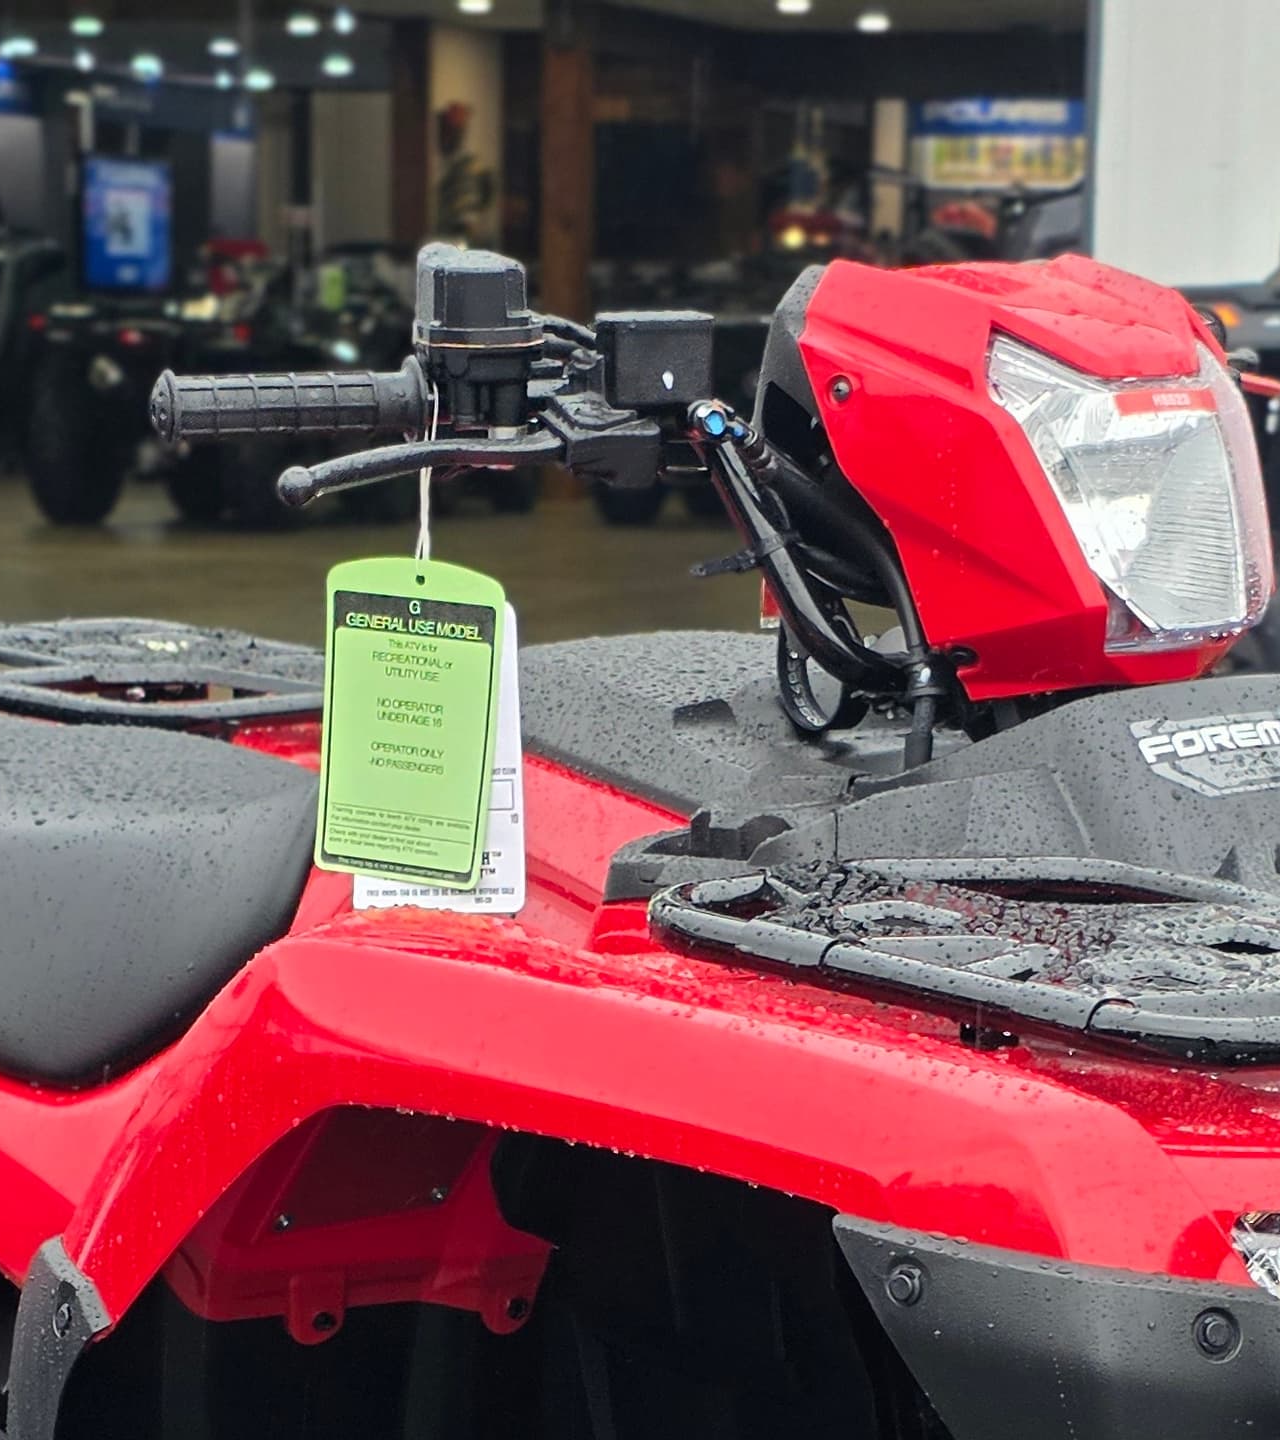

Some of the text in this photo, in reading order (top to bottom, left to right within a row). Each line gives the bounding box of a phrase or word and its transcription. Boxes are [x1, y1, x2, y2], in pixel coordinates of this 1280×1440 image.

[408, 600, 421, 615] G
[345, 612, 483, 641] GENERAL USE MODEL
[403, 640, 420, 652] ATV
[372, 651, 444, 669] RECREATIONAL
[385, 666, 440, 682] UTILITY USE
[376, 697, 444, 716] NO OPERATOR
[376, 710, 410, 724] UNDER
[410, 714, 431, 727] AGE
[370, 740, 445, 760] OPERATOR ONLY
[386, 758, 445, 776] PASSENGERS
